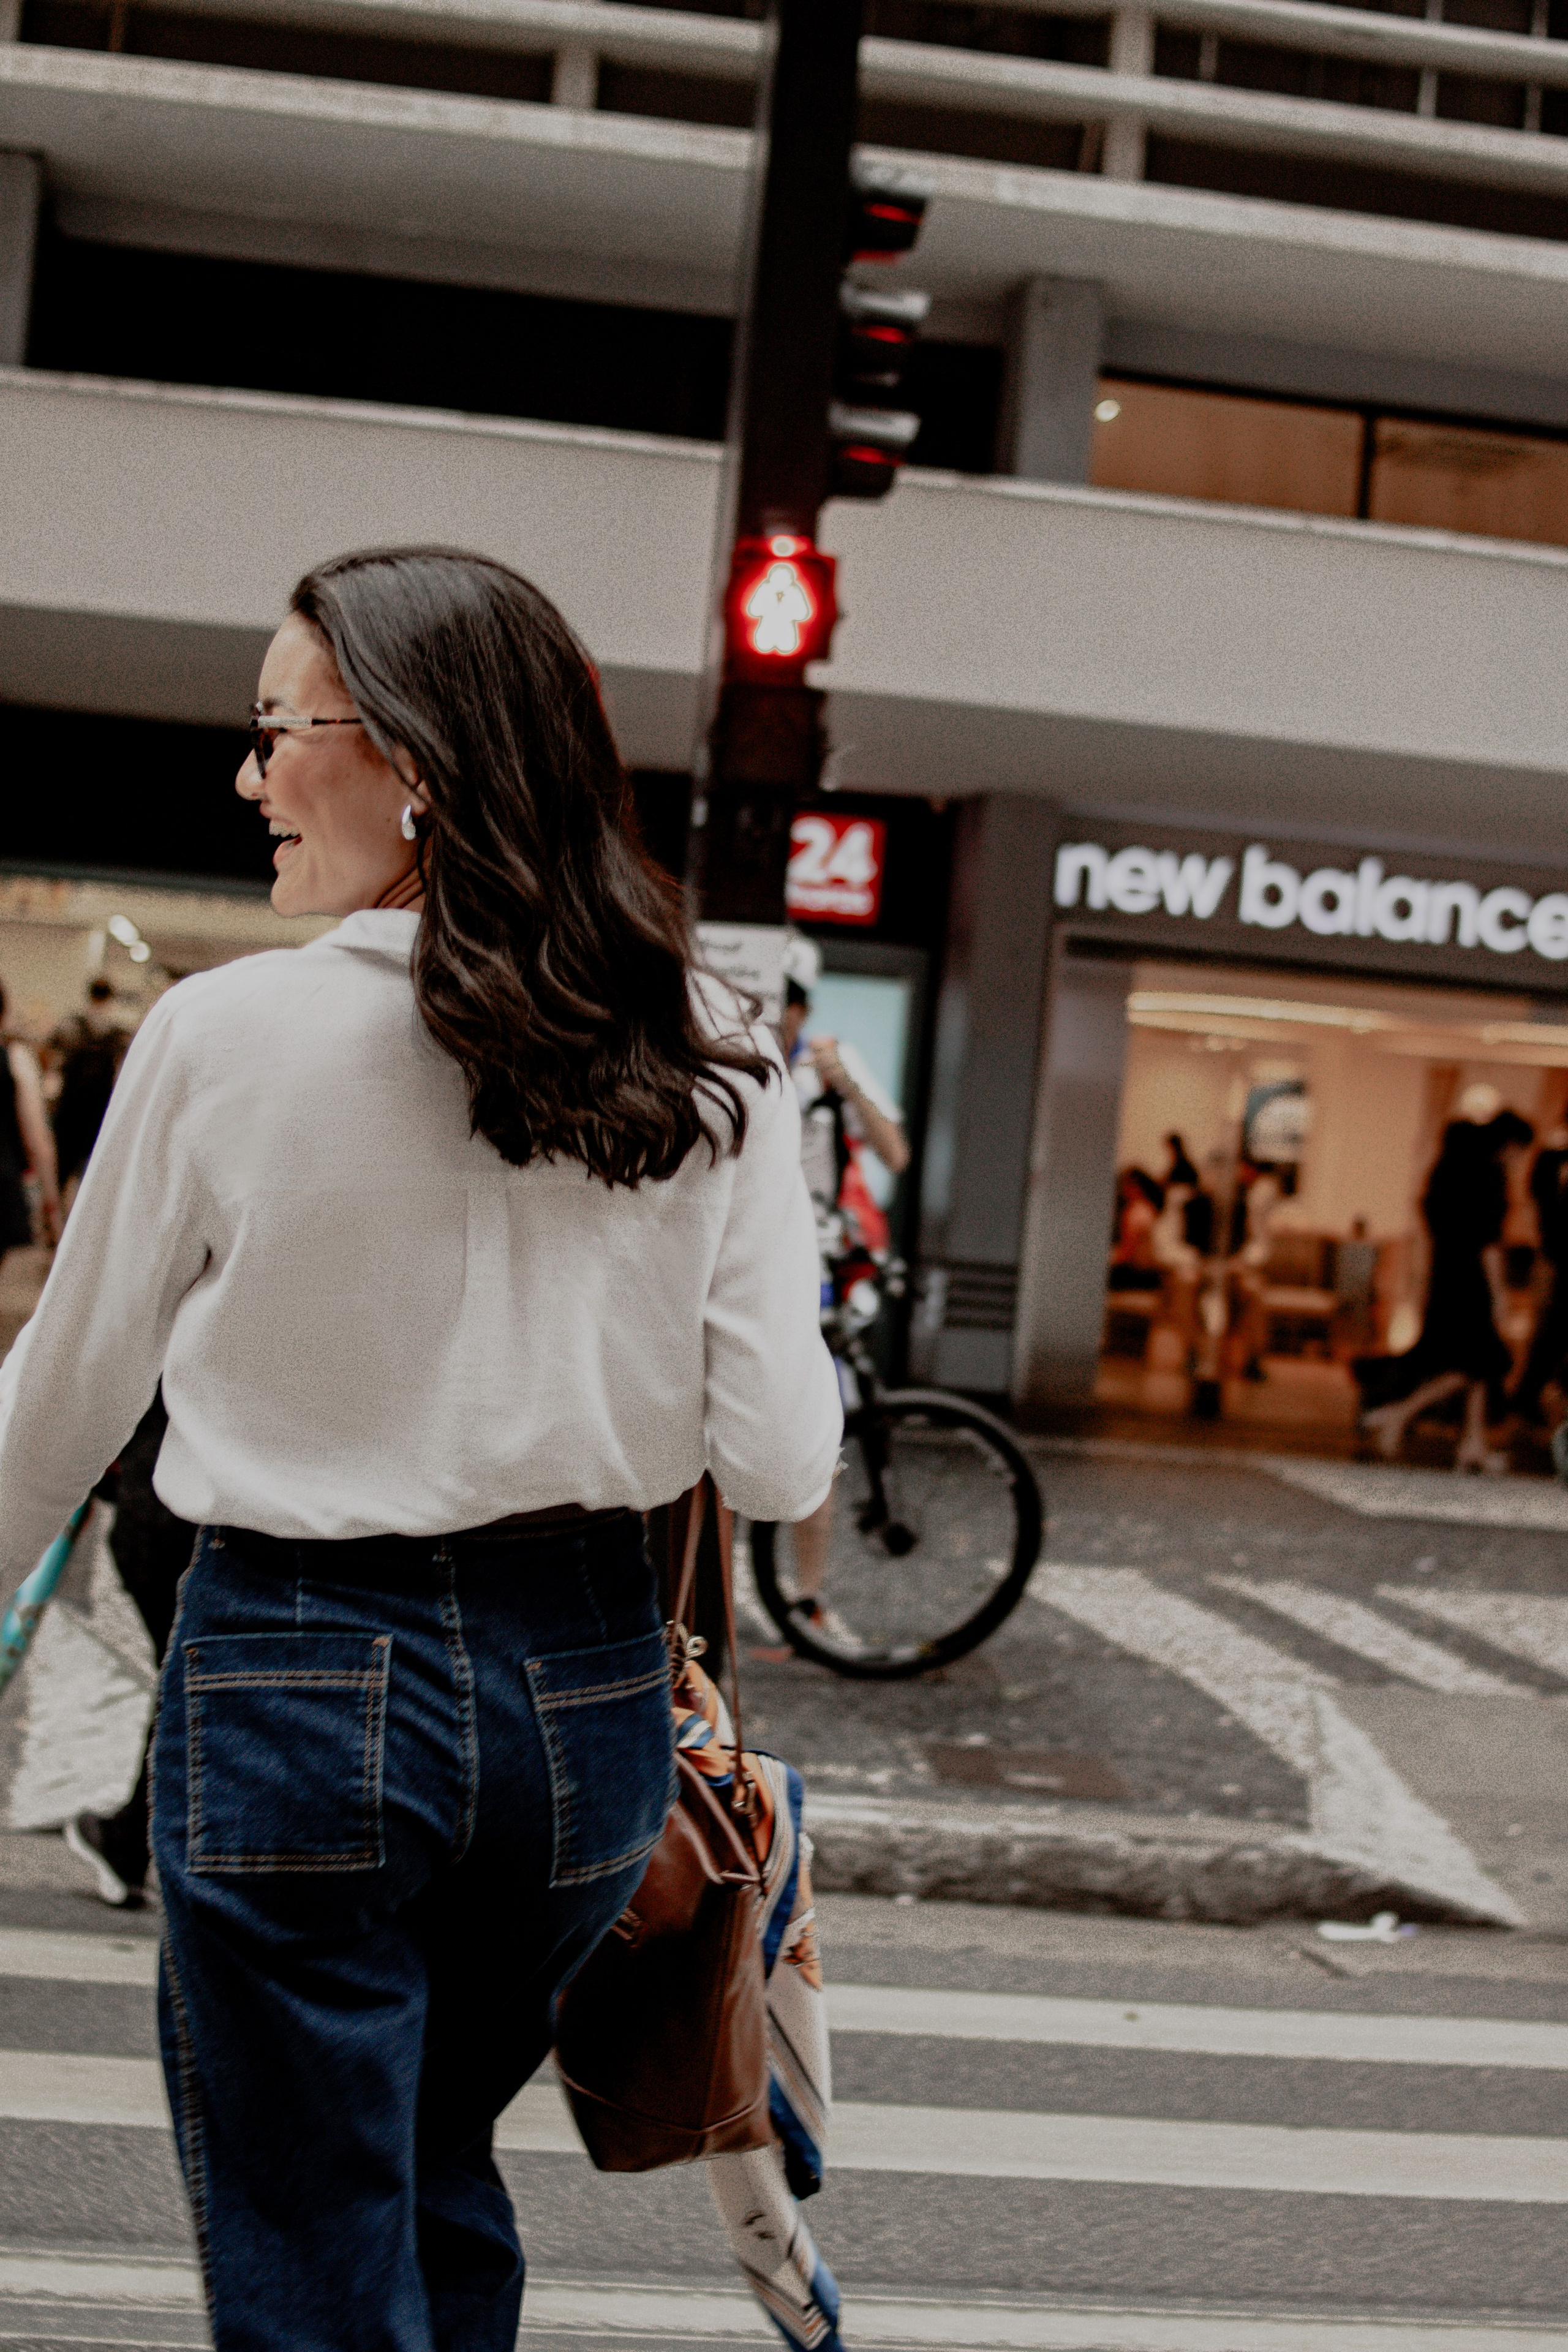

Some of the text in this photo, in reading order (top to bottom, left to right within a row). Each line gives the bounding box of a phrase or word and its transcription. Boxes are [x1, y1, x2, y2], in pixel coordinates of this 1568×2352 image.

[788, 816, 878, 884] 24
[1054, 842, 1568, 960] new balance
